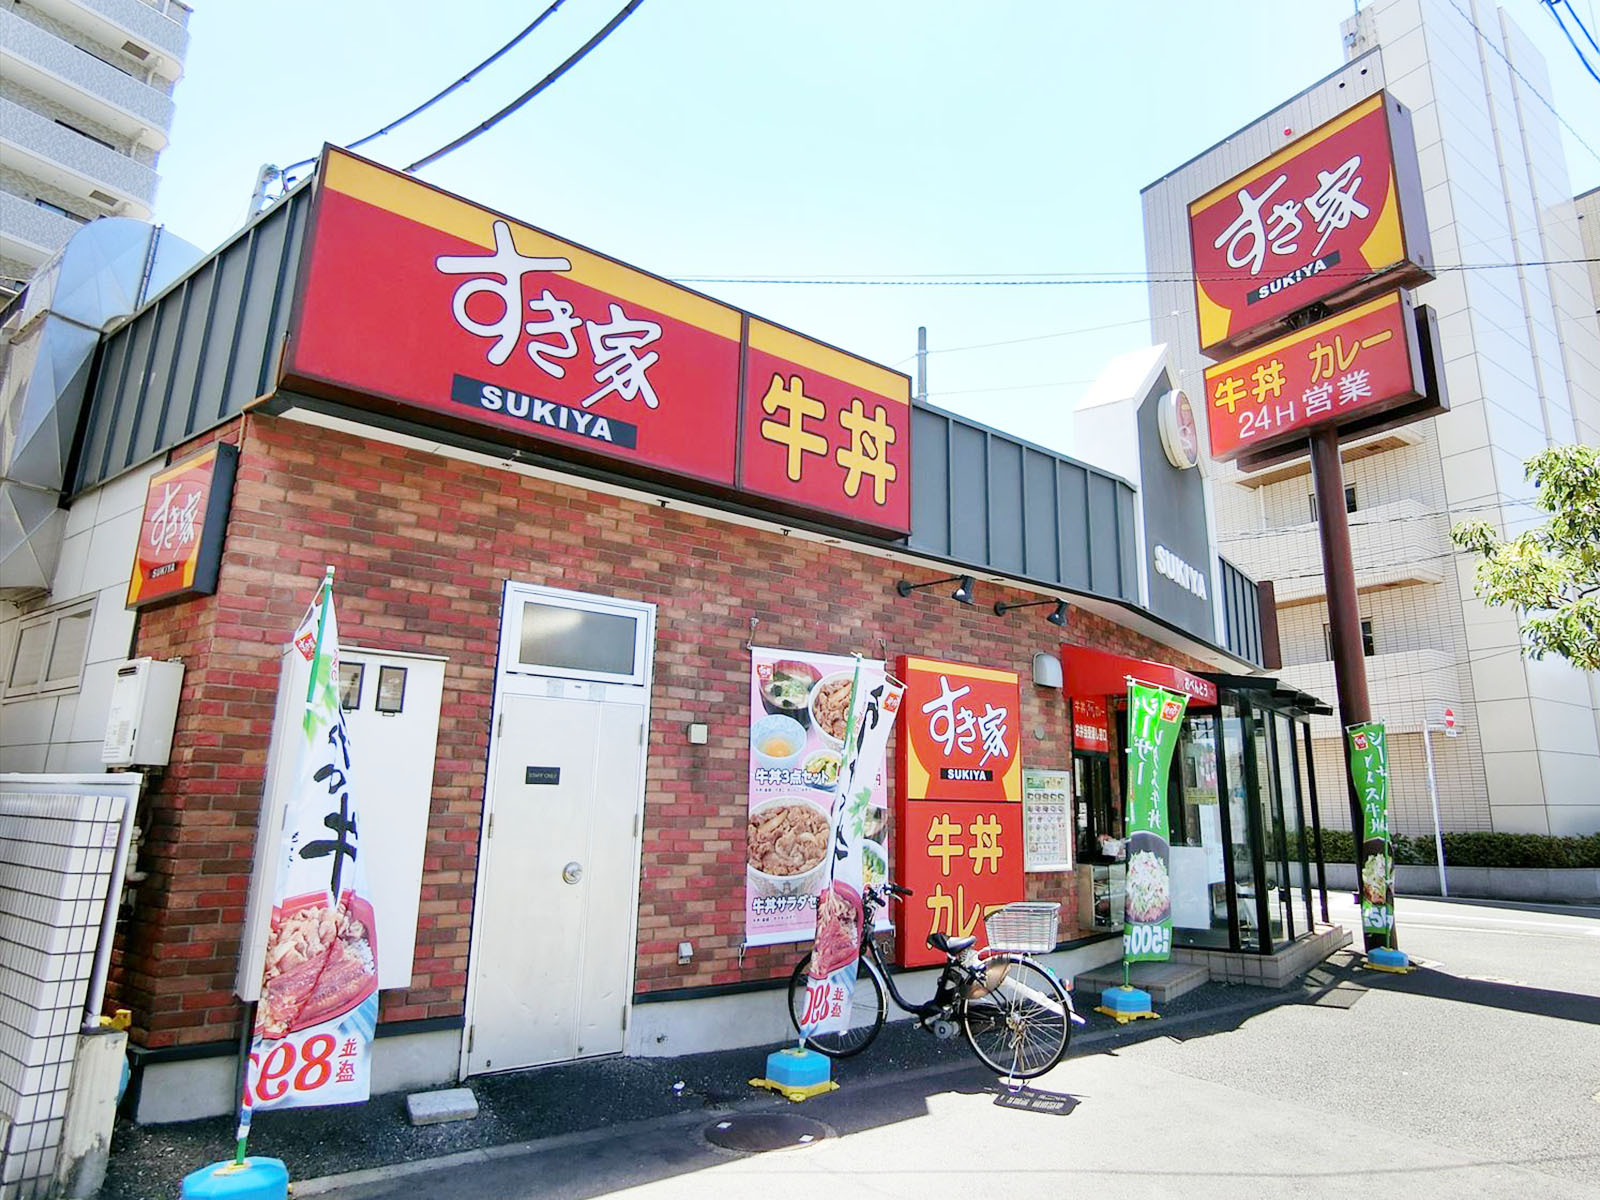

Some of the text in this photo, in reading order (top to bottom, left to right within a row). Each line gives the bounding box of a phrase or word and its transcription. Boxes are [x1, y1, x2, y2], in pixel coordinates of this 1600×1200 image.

[1212, 154, 1371, 276] すき家
[1258, 258, 1328, 300] SUKIYA
[435, 219, 662, 411] すき家
[1308, 329, 1393, 383] カレー
[479, 384, 614, 443] SUKIYA
[1214, 358, 1286, 413] 牛丼
[760, 372, 897, 506] 牛丼
[150, 482, 202, 559] すき家
[151, 562, 176, 579] SUKIYA
[1154, 544, 1208, 601] SUKIYA
[921, 674, 1009, 768] すき家
[755, 767, 830, 786] 牛丼3点セット
[947, 768, 987, 782] SUKIYA
[926, 812, 1004, 876] 牛丼
